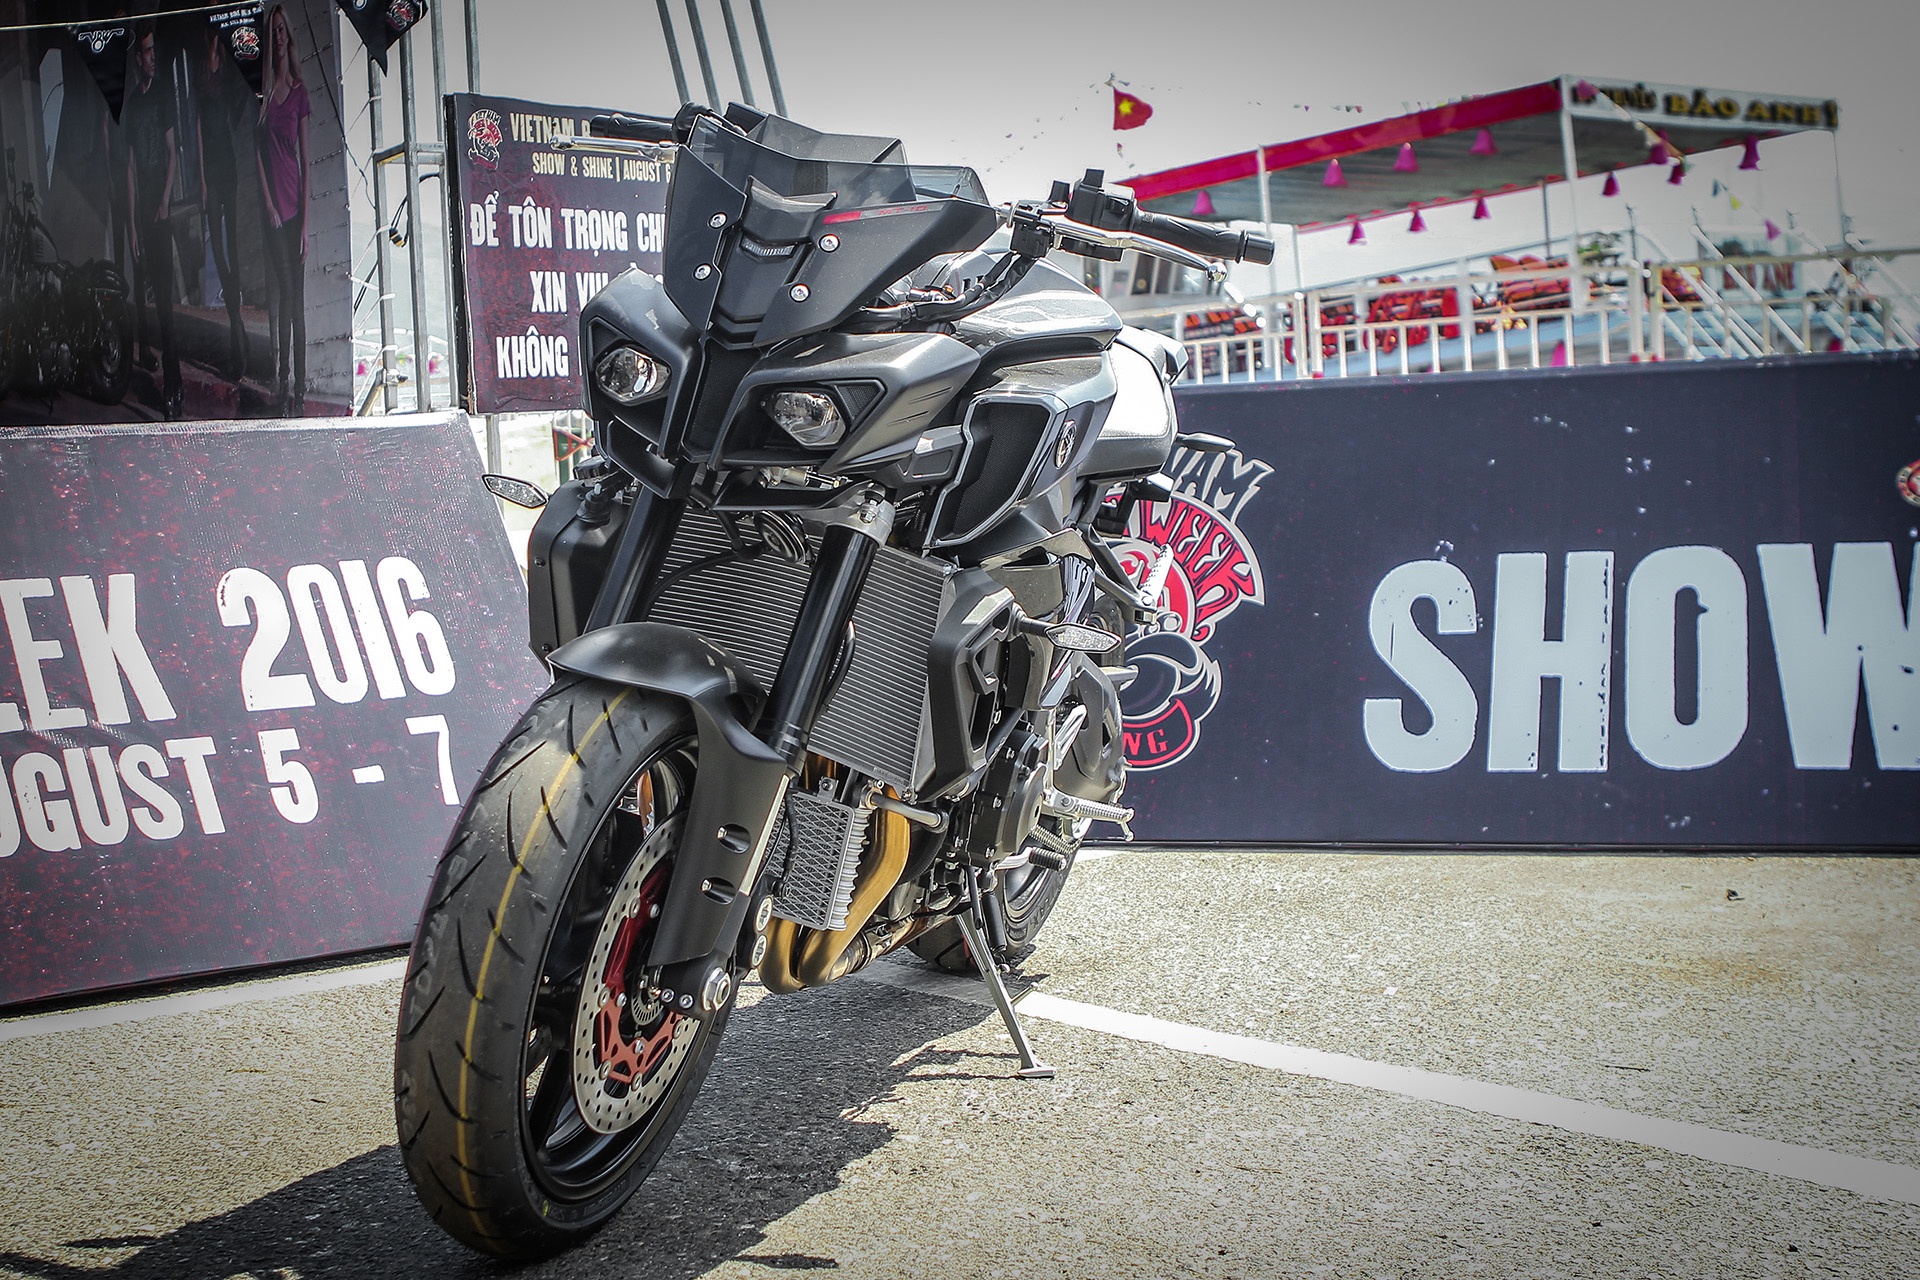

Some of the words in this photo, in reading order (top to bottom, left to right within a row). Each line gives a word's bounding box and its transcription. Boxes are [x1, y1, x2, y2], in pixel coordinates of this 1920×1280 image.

[532, 152, 565, 176] SHOW
[570, 156, 579, 177] &
[582, 157, 614, 179] SHINE
[623, 159, 662, 183] AUGUST
[469, 190, 500, 247] ĐỂ
[508, 196, 553, 249] TÔN
[560, 207, 629, 257] TRỌNG
[878, 204, 928, 216] MT-10
[529, 270, 567, 314] XIN
[495, 325, 571, 379] KHÔNG
[0, 573, 177, 733] EK
[216, 556, 456, 713] 2016
[1364, 541, 1920, 773] SHOW
[257, 728, 320, 824] 5
[405, 714, 460, 806] 7
